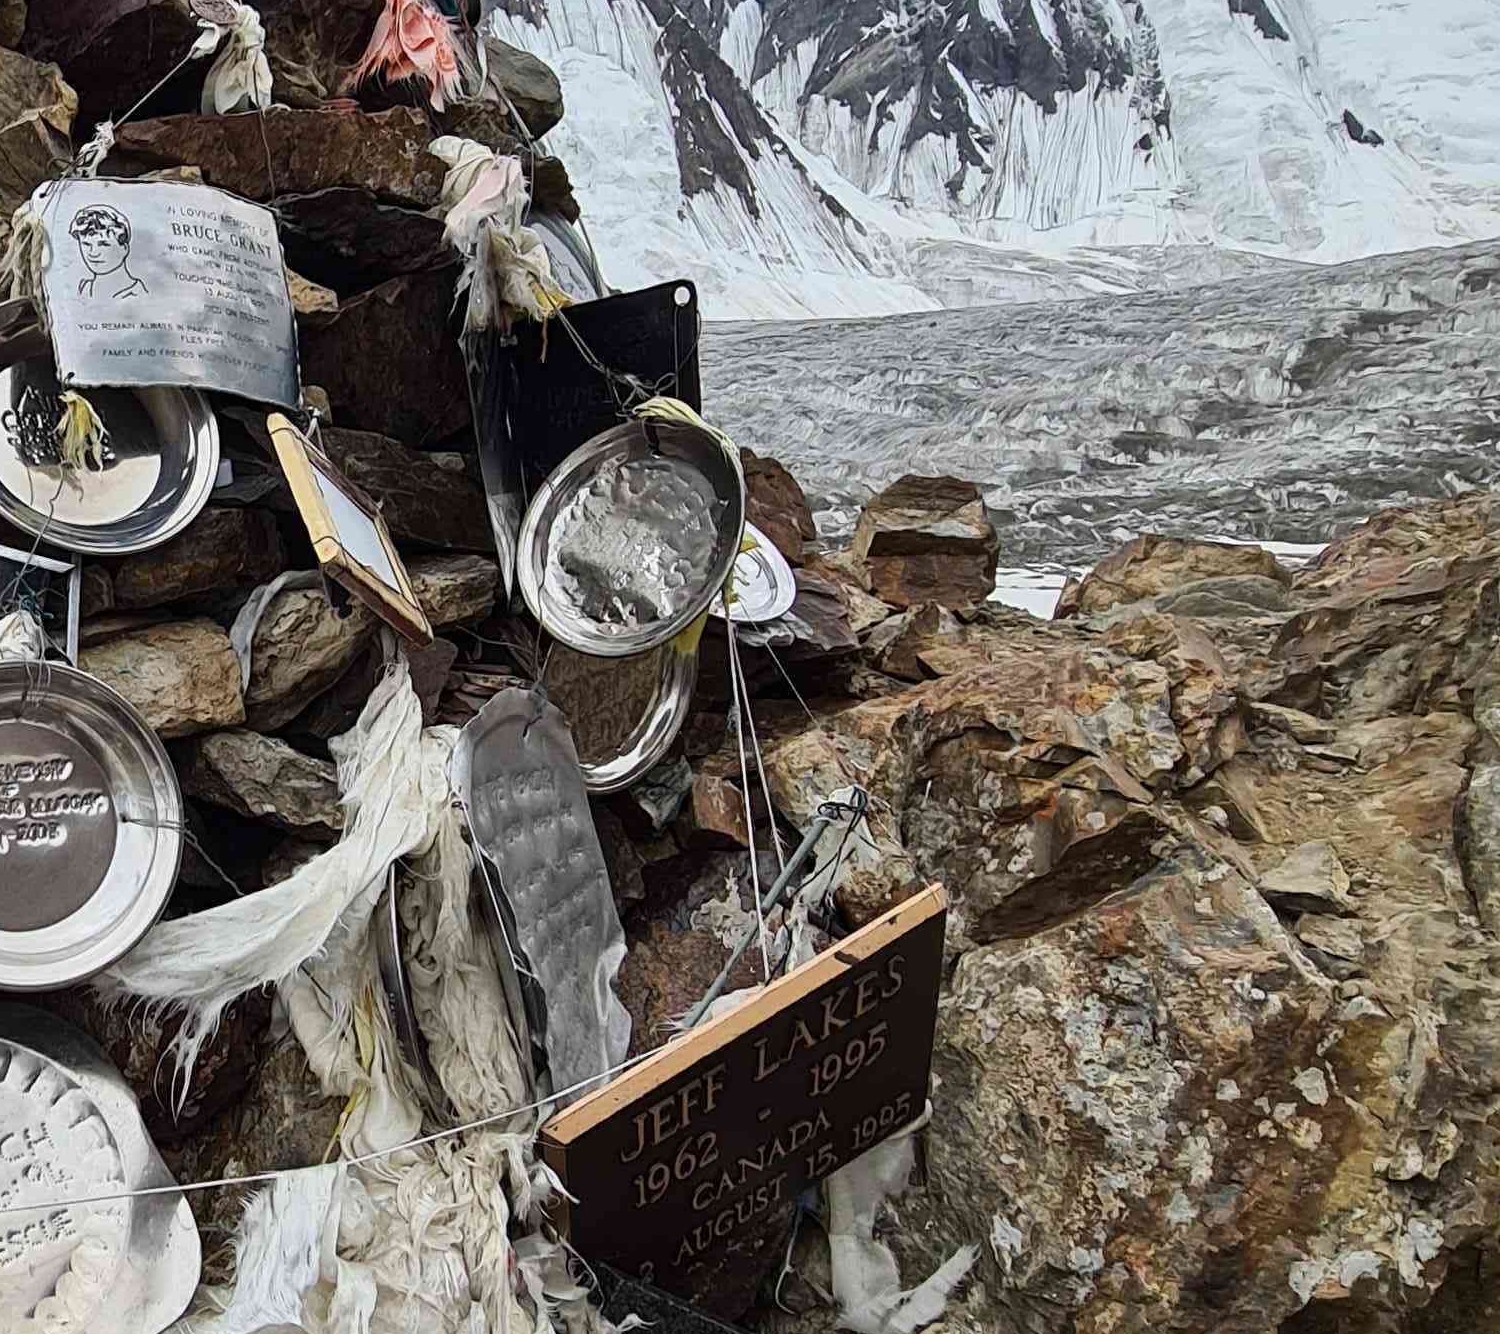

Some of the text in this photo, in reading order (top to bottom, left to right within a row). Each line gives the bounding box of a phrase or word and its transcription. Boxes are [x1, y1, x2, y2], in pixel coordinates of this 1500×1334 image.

[171, 222, 272, 259] BRUCE GRANT
[621, 953, 906, 1164] JEFF LAKES
[634, 1021, 888, 1209] 1962 1995
[673, 1172, 788, 1267] AUGUST
[851, 1092, 912, 1150] 1995
[692, 1106, 833, 1211] CANADA
